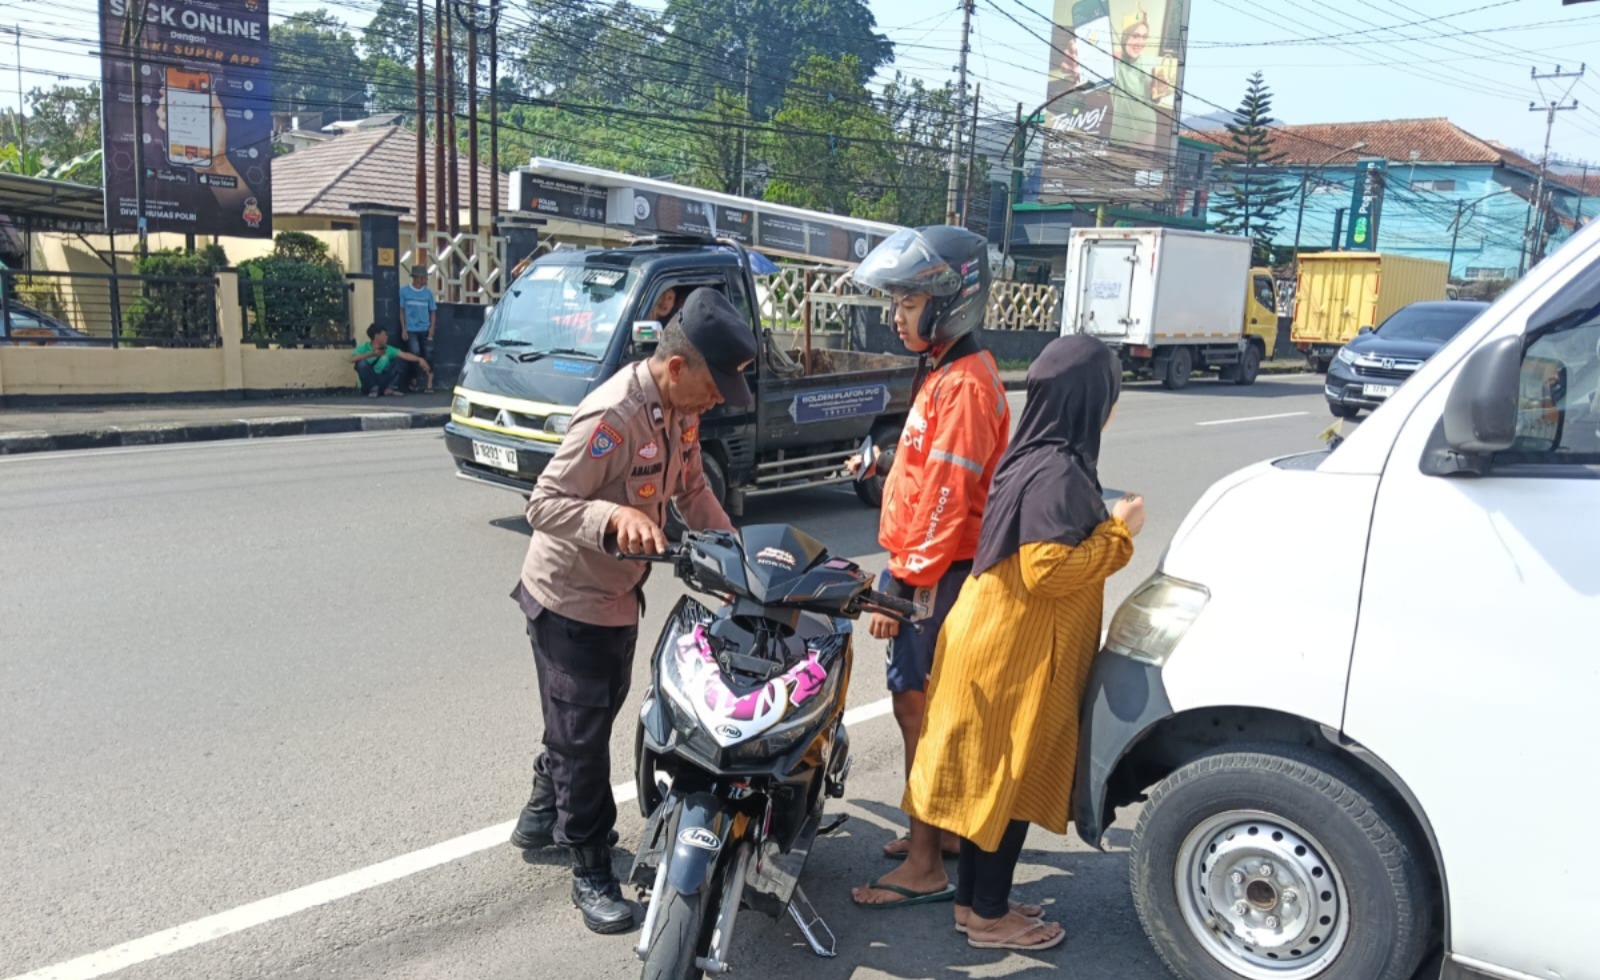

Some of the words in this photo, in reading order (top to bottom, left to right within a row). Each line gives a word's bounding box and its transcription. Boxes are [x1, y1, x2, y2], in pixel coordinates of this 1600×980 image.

[110, 0, 176, 27] SCK
[181, 10, 261, 41] ONLINE
[170, 31, 206, 44] Dengan
[174, 44, 224, 61] SUPER
[230, 53, 260, 66] APP
[1358, 162, 1377, 214] Pegadan
[145, 209, 173, 218] HUMAS
[174, 212, 197, 221] POLRI
[917, 486, 951, 554] SopeeFood
[757, 558, 792, 571] HONDA
[687, 829, 715, 846] Arai
